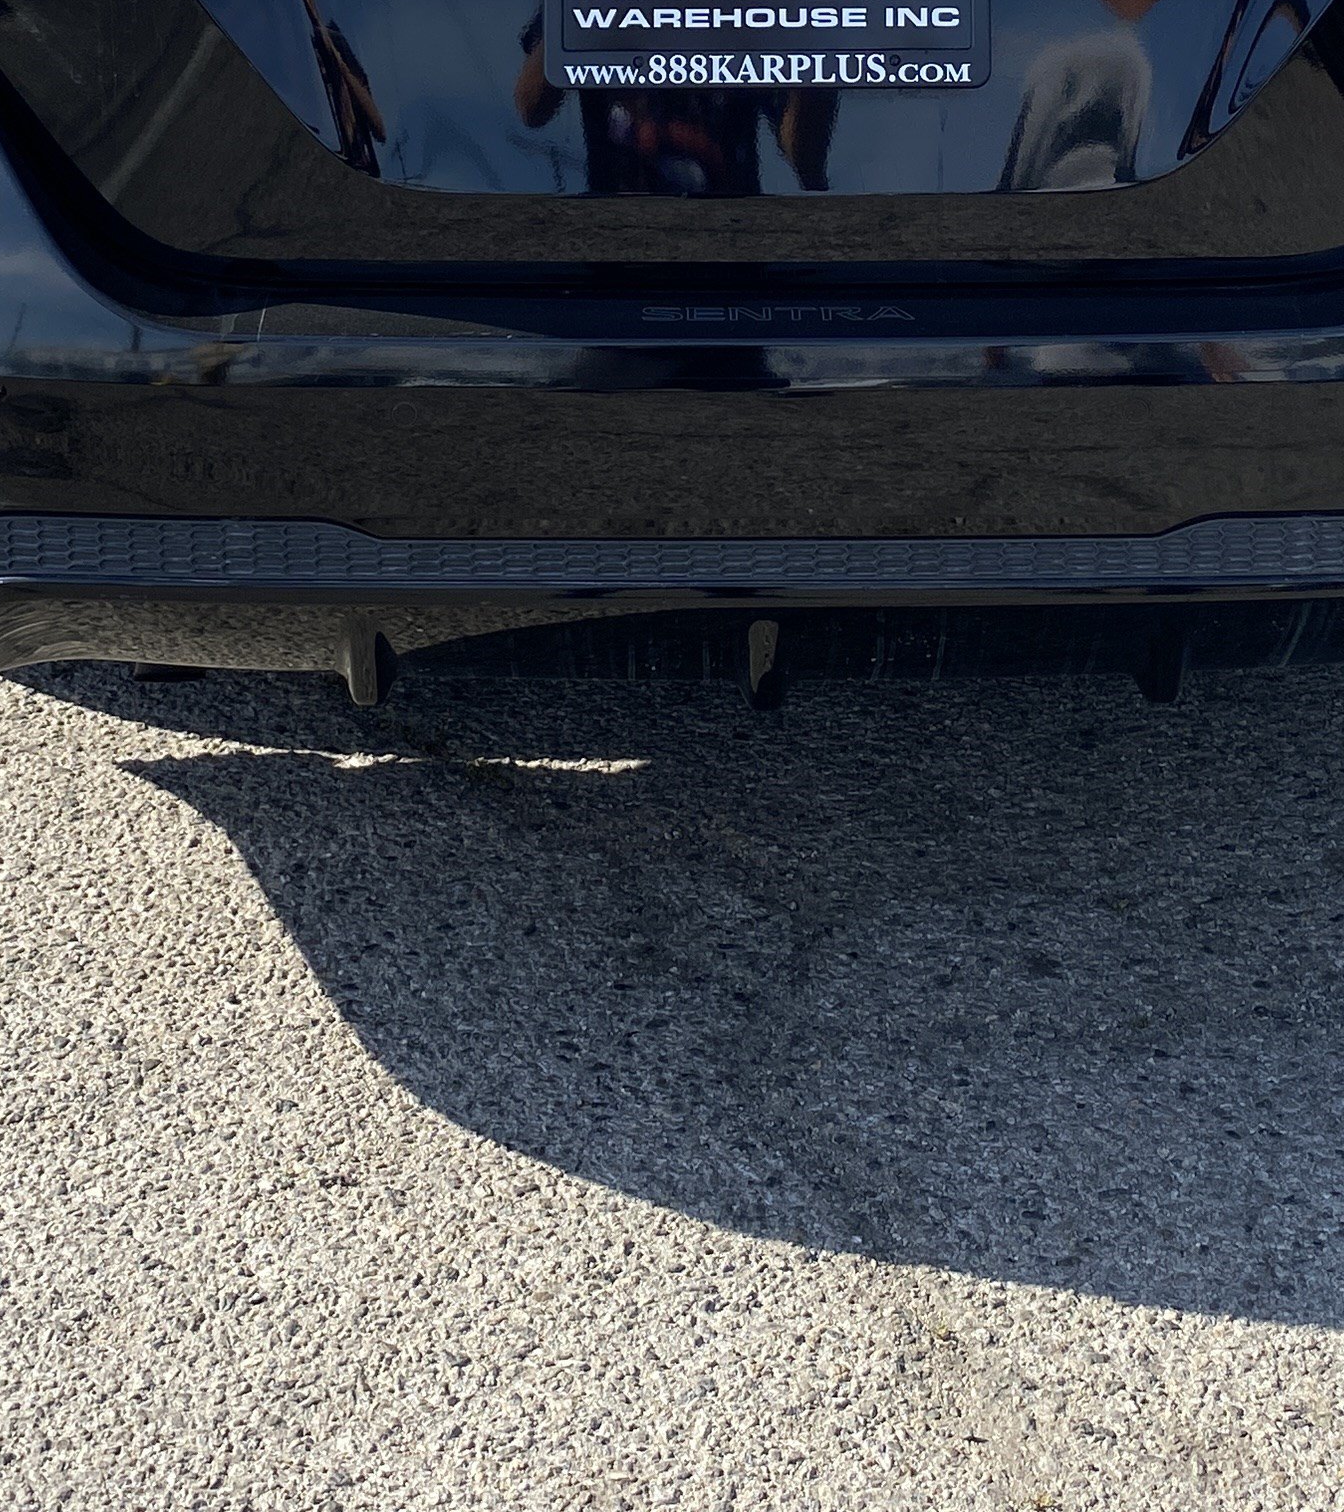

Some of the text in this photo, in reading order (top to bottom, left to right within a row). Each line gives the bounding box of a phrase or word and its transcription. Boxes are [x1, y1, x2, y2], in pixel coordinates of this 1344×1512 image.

[573, 7, 960, 29] WAREHOUSE INC
[641, 305, 916, 322] SENTRA
